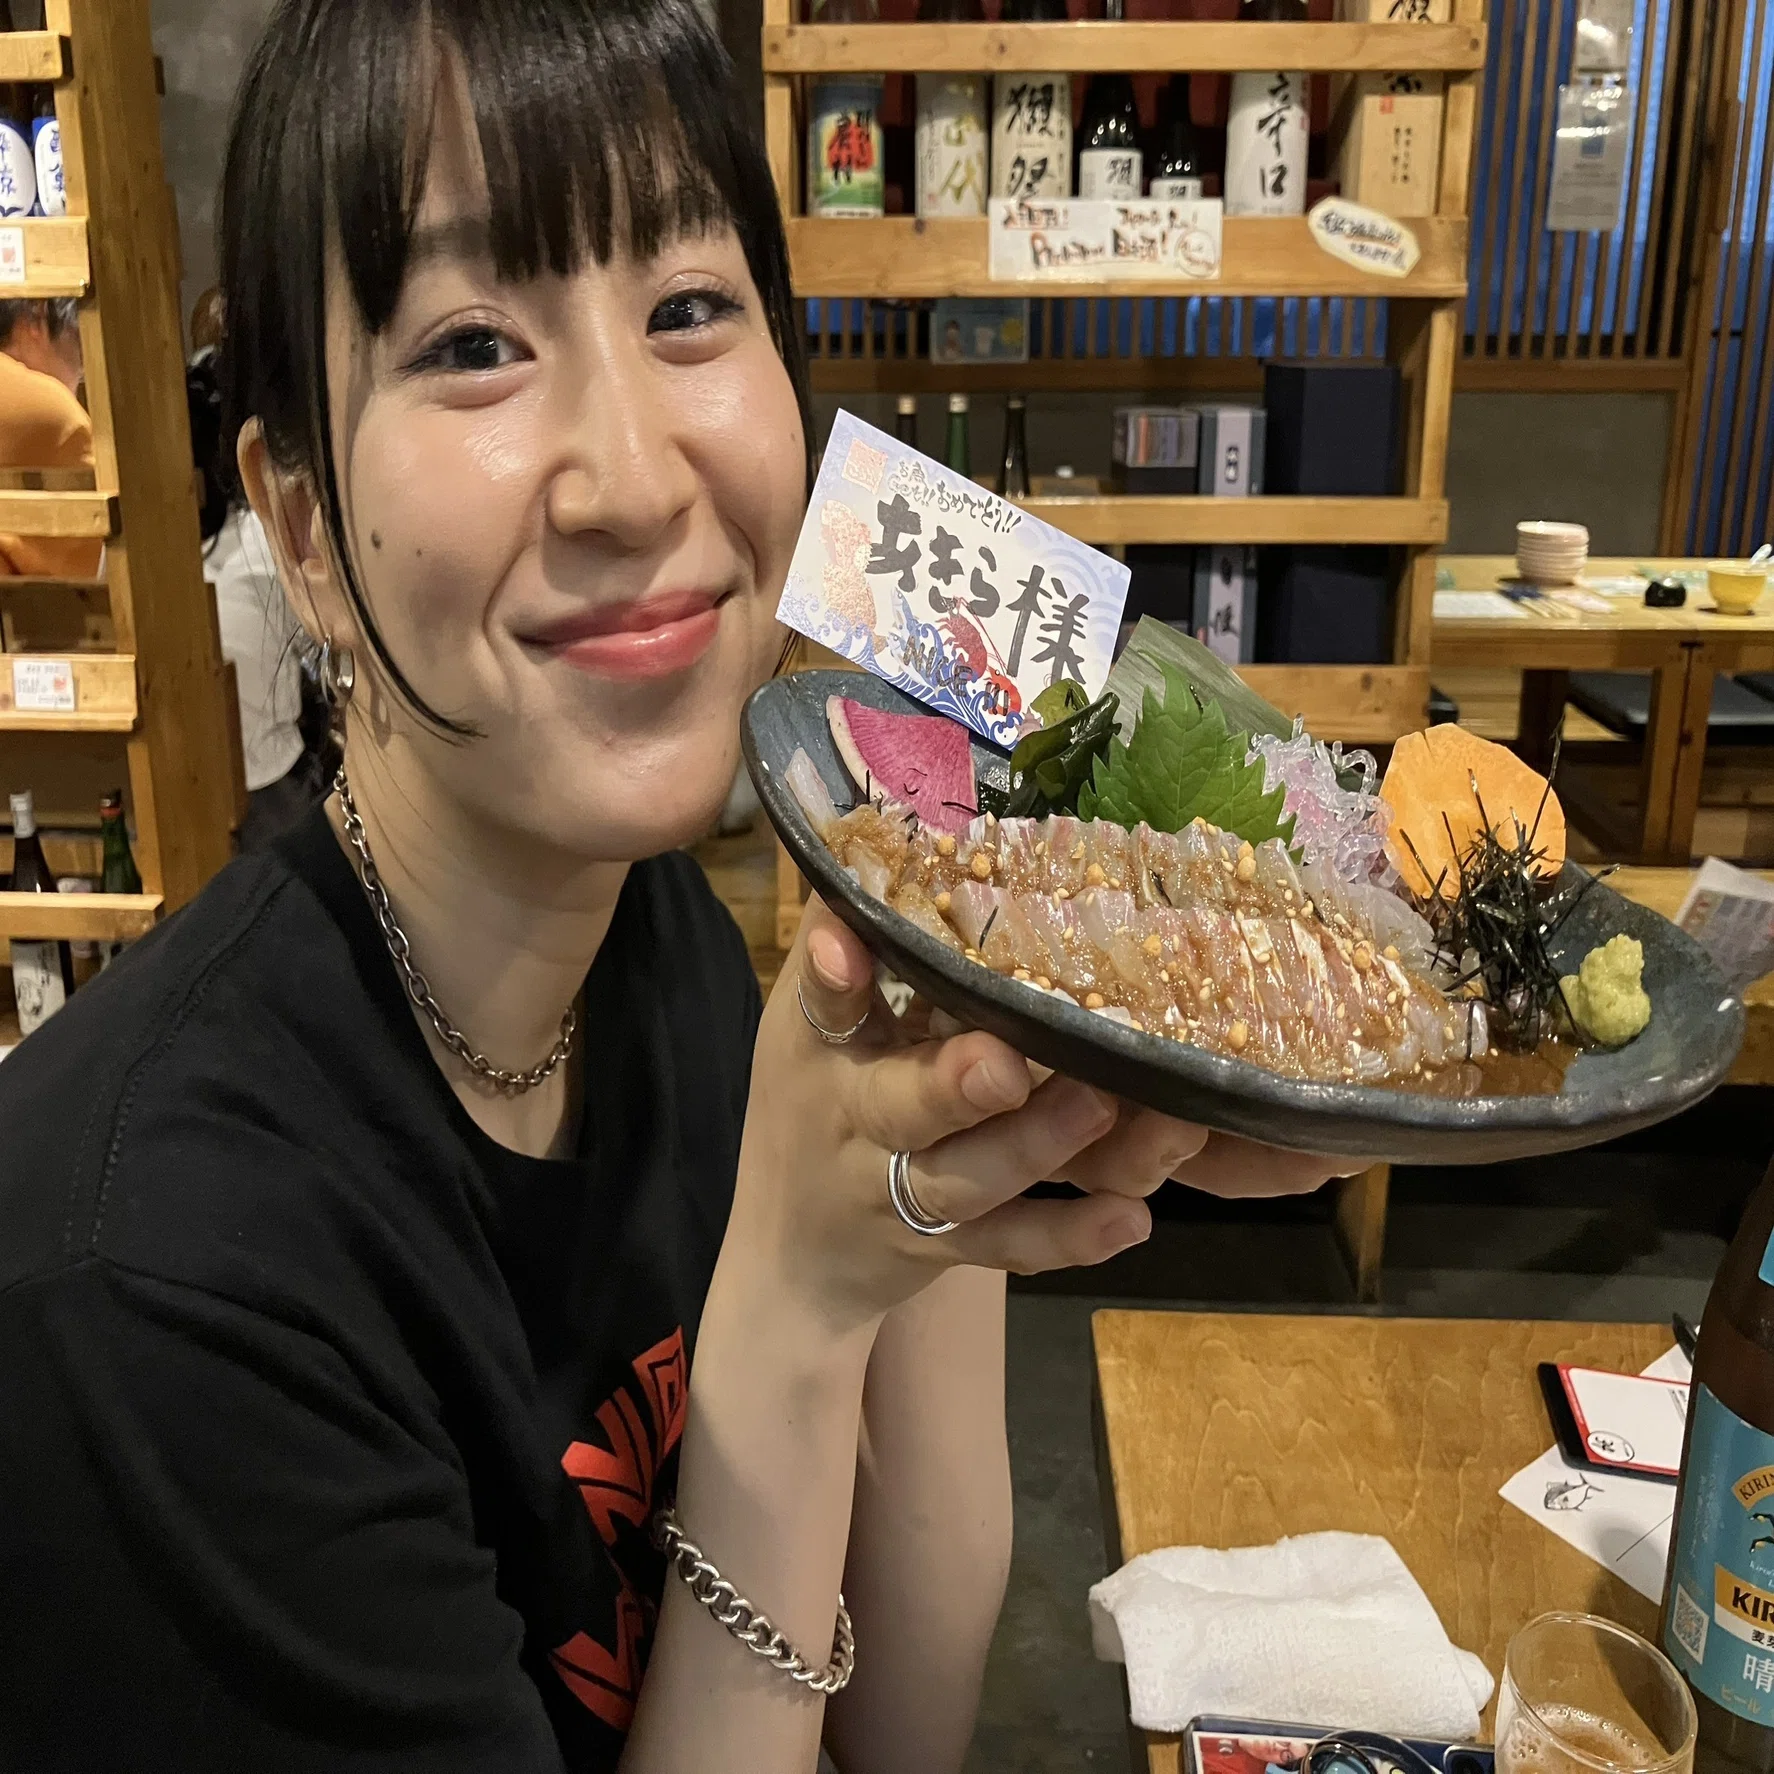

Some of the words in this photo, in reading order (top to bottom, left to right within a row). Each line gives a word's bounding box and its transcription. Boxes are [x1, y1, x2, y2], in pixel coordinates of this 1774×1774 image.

[864, 493, 1091, 686] あきら様
[1743, 1653, 1774, 1693] 晴
